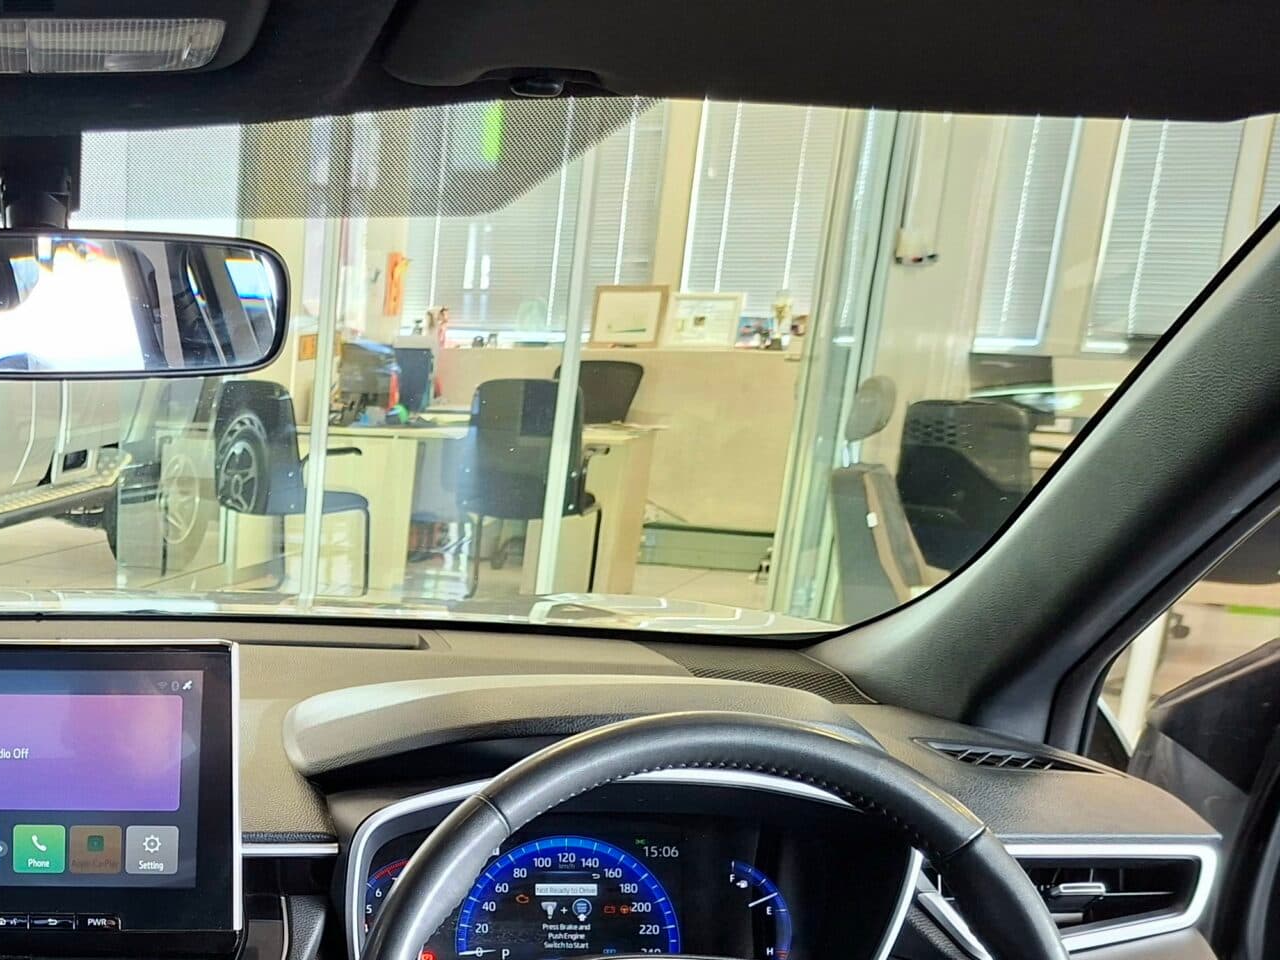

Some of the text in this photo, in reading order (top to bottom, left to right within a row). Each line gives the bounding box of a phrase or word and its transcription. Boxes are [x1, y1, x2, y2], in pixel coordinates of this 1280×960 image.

[13, 748, 29, 759] Off
[643, 846, 679, 858] 15:06
[27, 858, 50, 868] Phone
[533, 857, 552, 868] 100
[558, 853, 576, 863] 120
[581, 857, 600, 868] 140
[138, 860, 164, 871] Setting
[513, 868, 527, 878] 80
[603, 868, 622, 878] 160
[729, 874, 735, 883] F
[375, 888, 382, 898] 6
[495, 883, 509, 893] 60
[619, 883, 638, 894] 180
[366, 904, 373, 914] 5
[482, 901, 496, 912] 40
[631, 902, 651, 913] 200
[766, 906, 773, 915] E
[87, 918, 107, 926] PWR
[475, 923, 489, 934] 20
[639, 924, 660, 935] 220
[564, 933, 585, 941] Engine
[543, 941, 565, 949] Switch
[475, 946, 483, 957] 0
[502, 949, 510, 960] P
[766, 947, 774, 956] H
